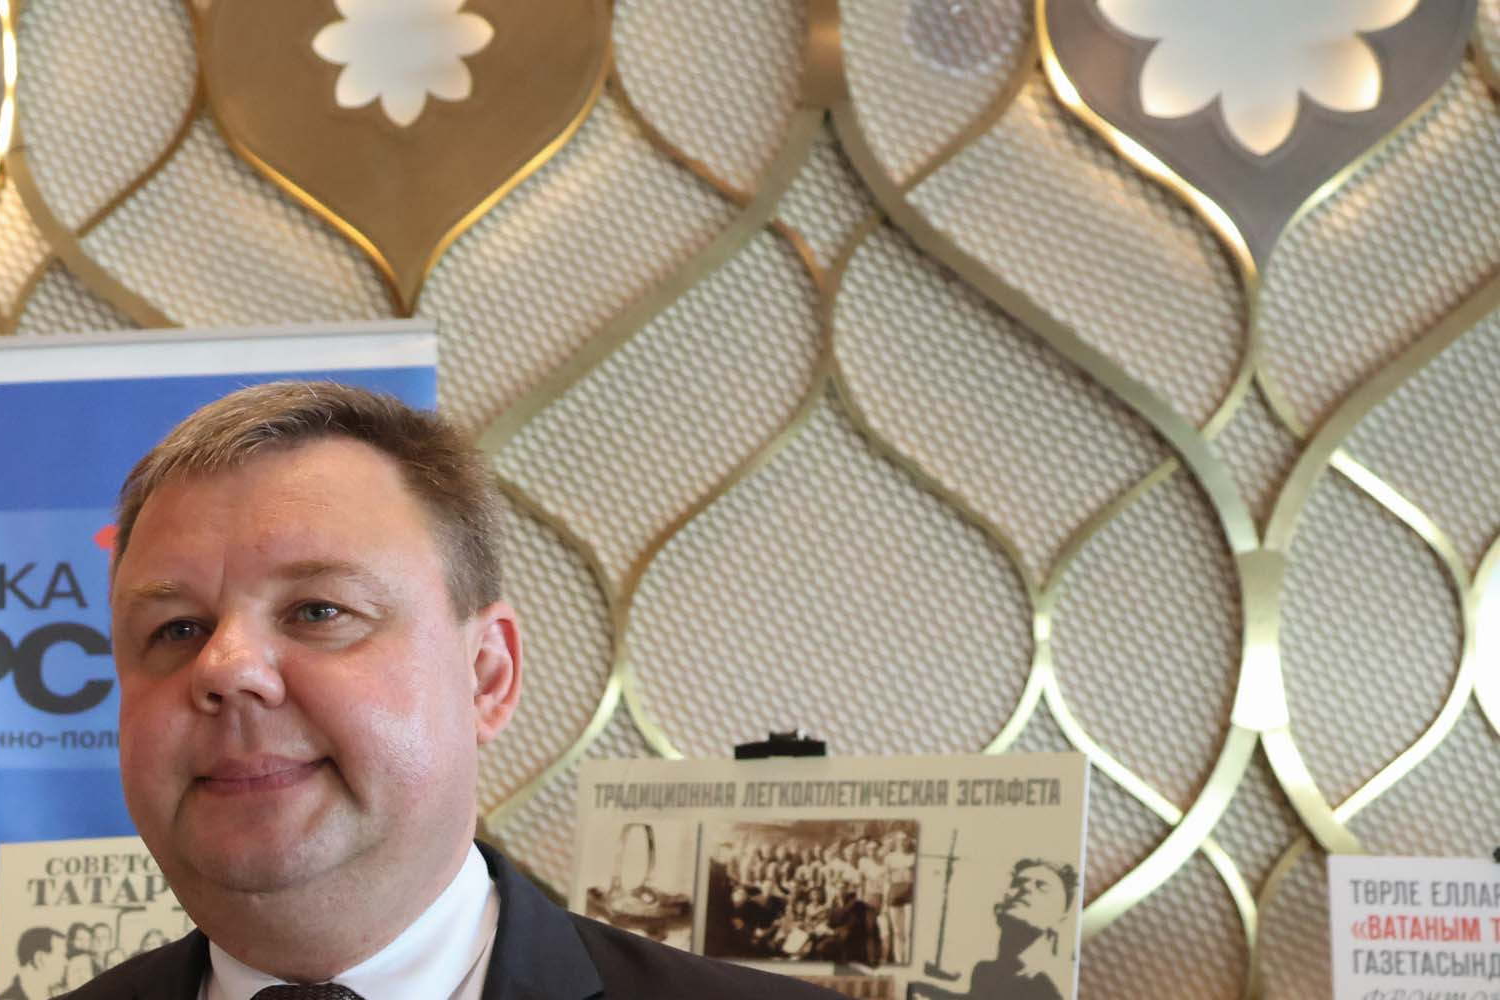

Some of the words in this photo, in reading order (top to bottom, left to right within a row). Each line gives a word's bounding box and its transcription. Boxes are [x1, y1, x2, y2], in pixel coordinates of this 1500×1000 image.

[594, 782, 737, 811] ТРАДИЦИОННАЯ
[743, 779, 949, 807] ЛЕГКОАТЛЕТИЧЕСКАЯ
[956, 777, 1061, 807] ЭСТАФЕТА
[28, 875, 168, 907] ТАТАР
[1350, 879, 1421, 906] ТӨРЛЕ
[1352, 915, 1481, 943] «ВАТАНЫМ
